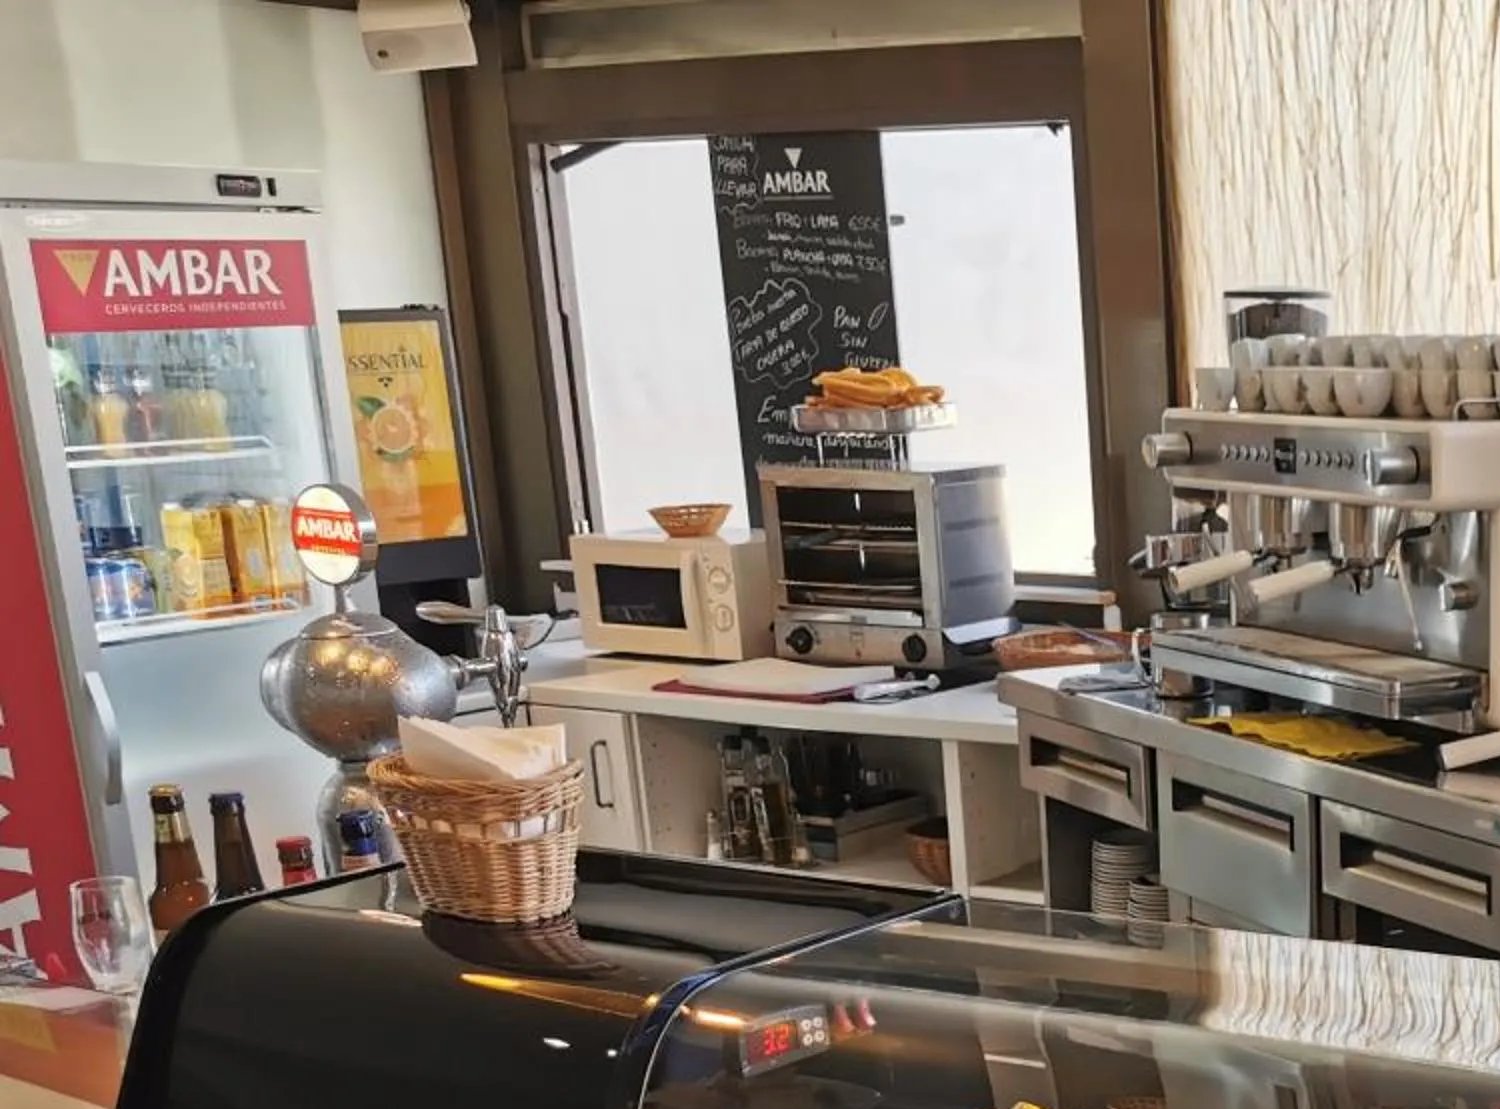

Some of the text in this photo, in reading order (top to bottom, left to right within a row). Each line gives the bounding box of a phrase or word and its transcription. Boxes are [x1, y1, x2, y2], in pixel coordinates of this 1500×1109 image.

[764, 170, 830, 193] AMBAR
[104, 249, 282, 296] AMBAR
[105, 301, 287, 315] CERVECEROS INDEPENDIENTES
[348, 352, 428, 369] SSENTIAL
[298, 515, 357, 542] AMBAR
